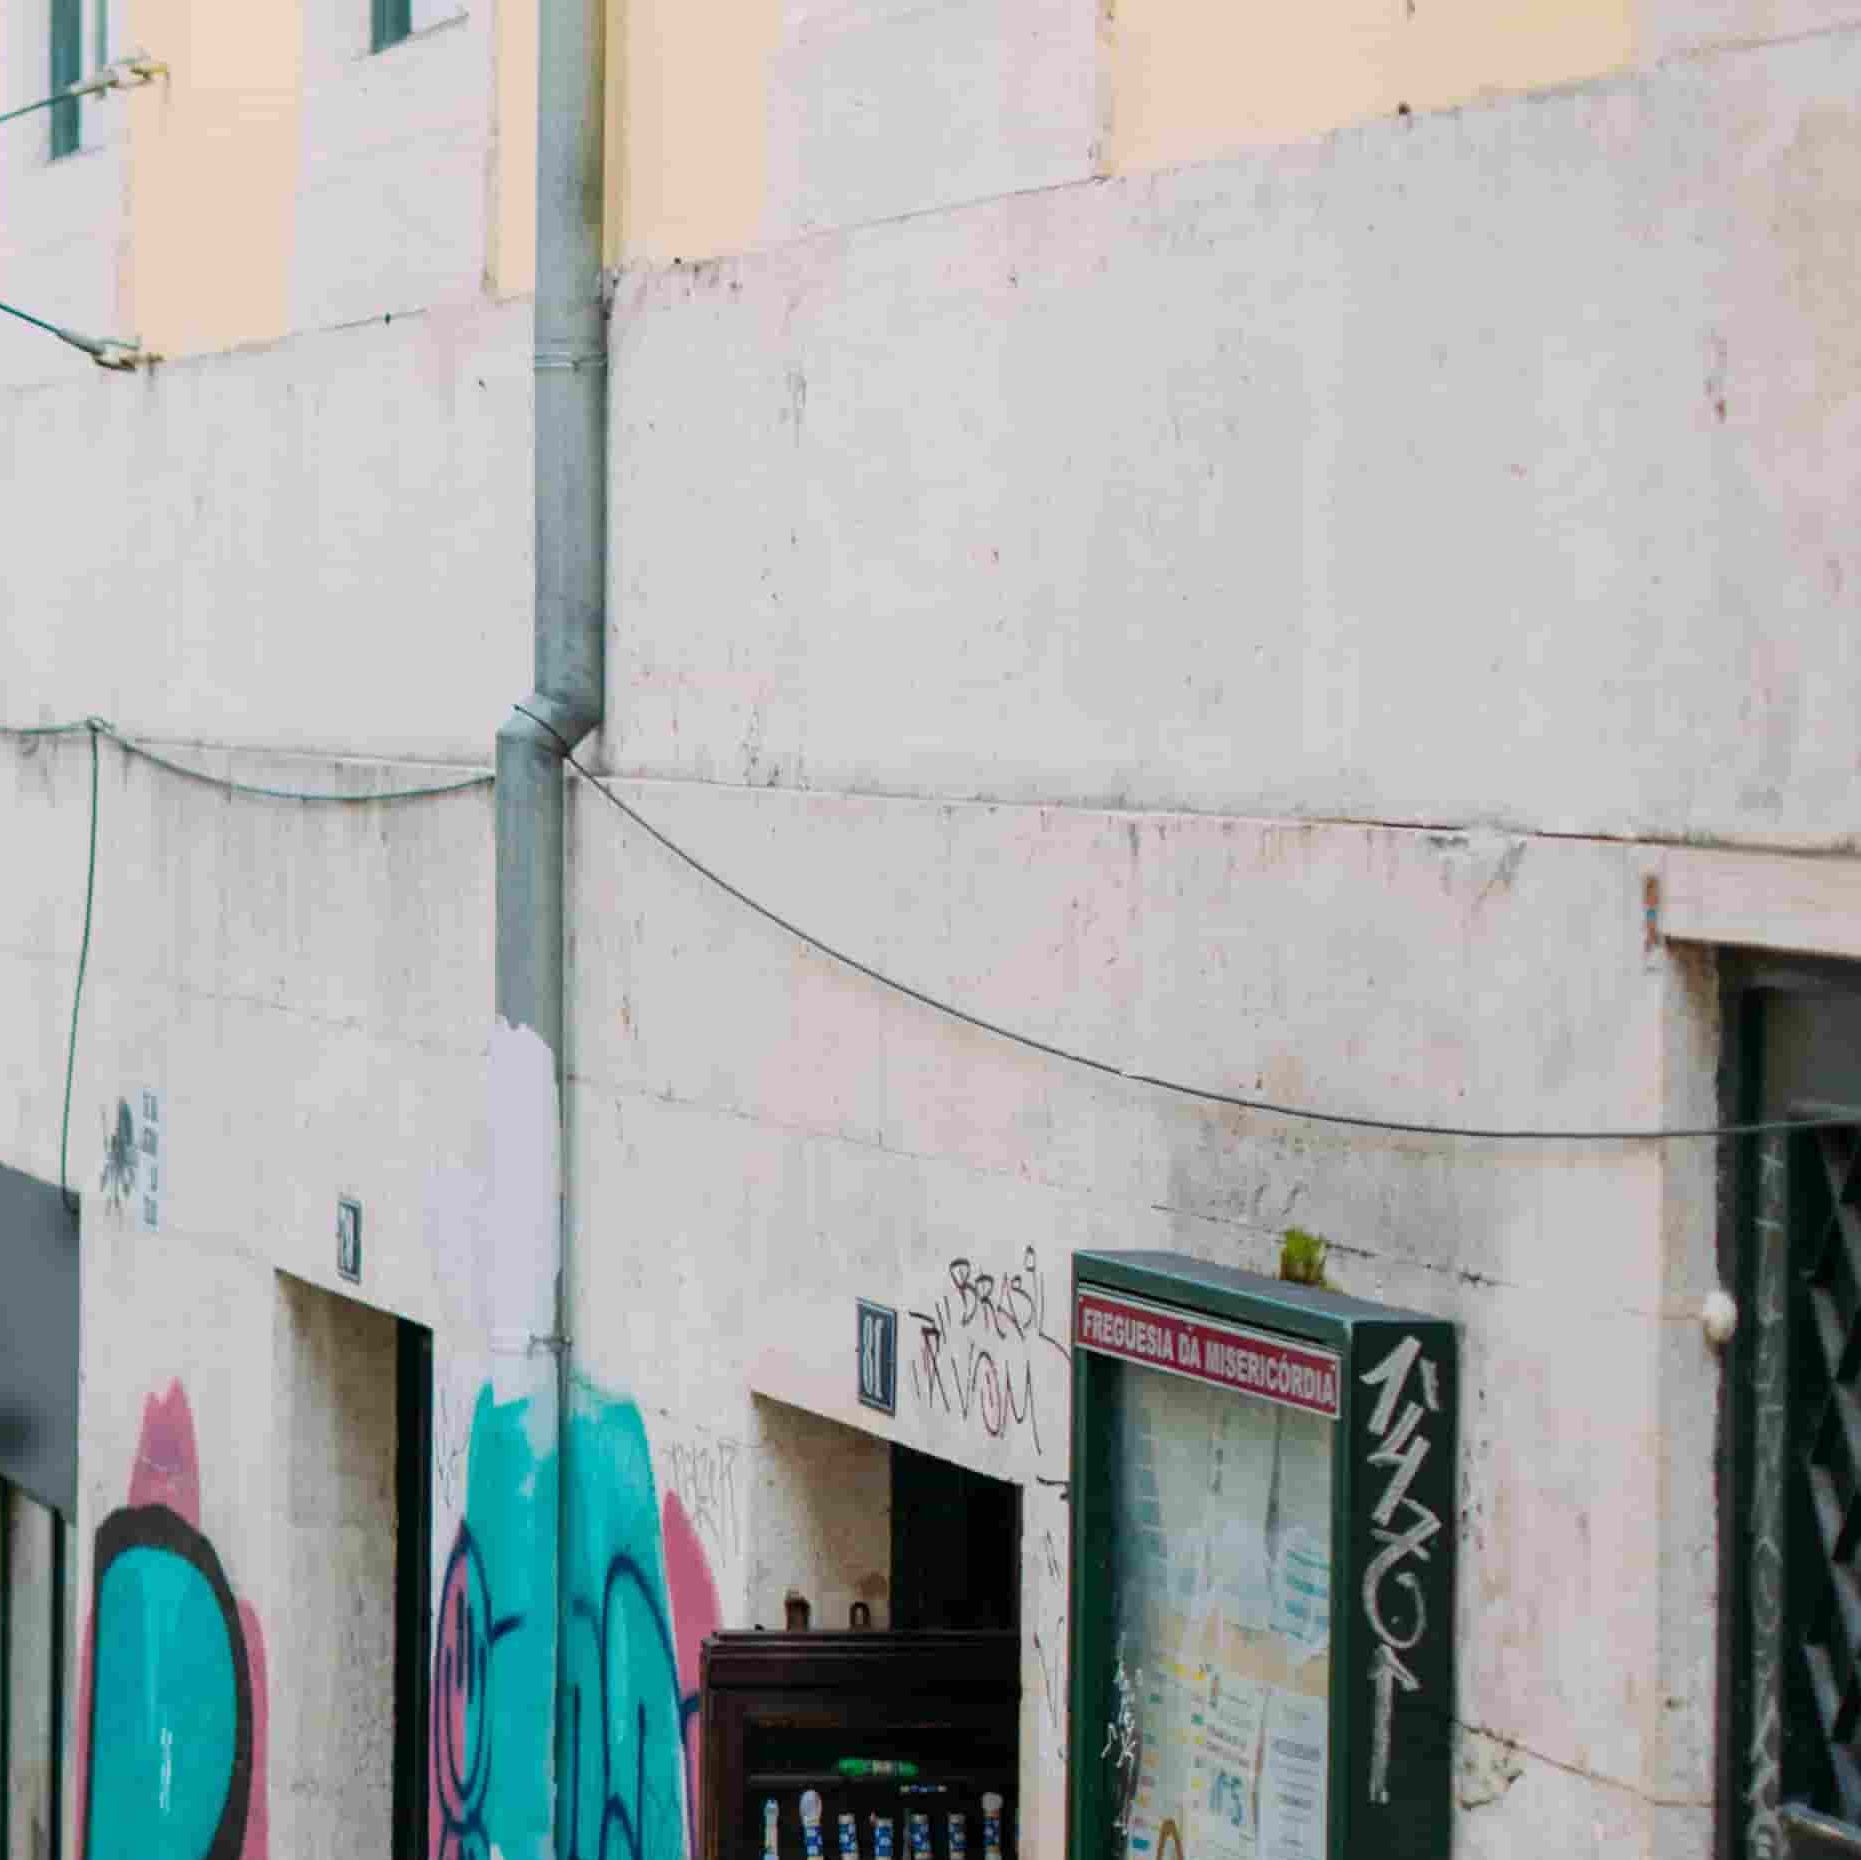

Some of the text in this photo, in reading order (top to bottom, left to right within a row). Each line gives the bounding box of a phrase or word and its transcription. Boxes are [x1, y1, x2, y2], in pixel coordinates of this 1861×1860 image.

[1082, 1308, 1336, 1406] FREGUESIA DA MISERICÓRDIA
